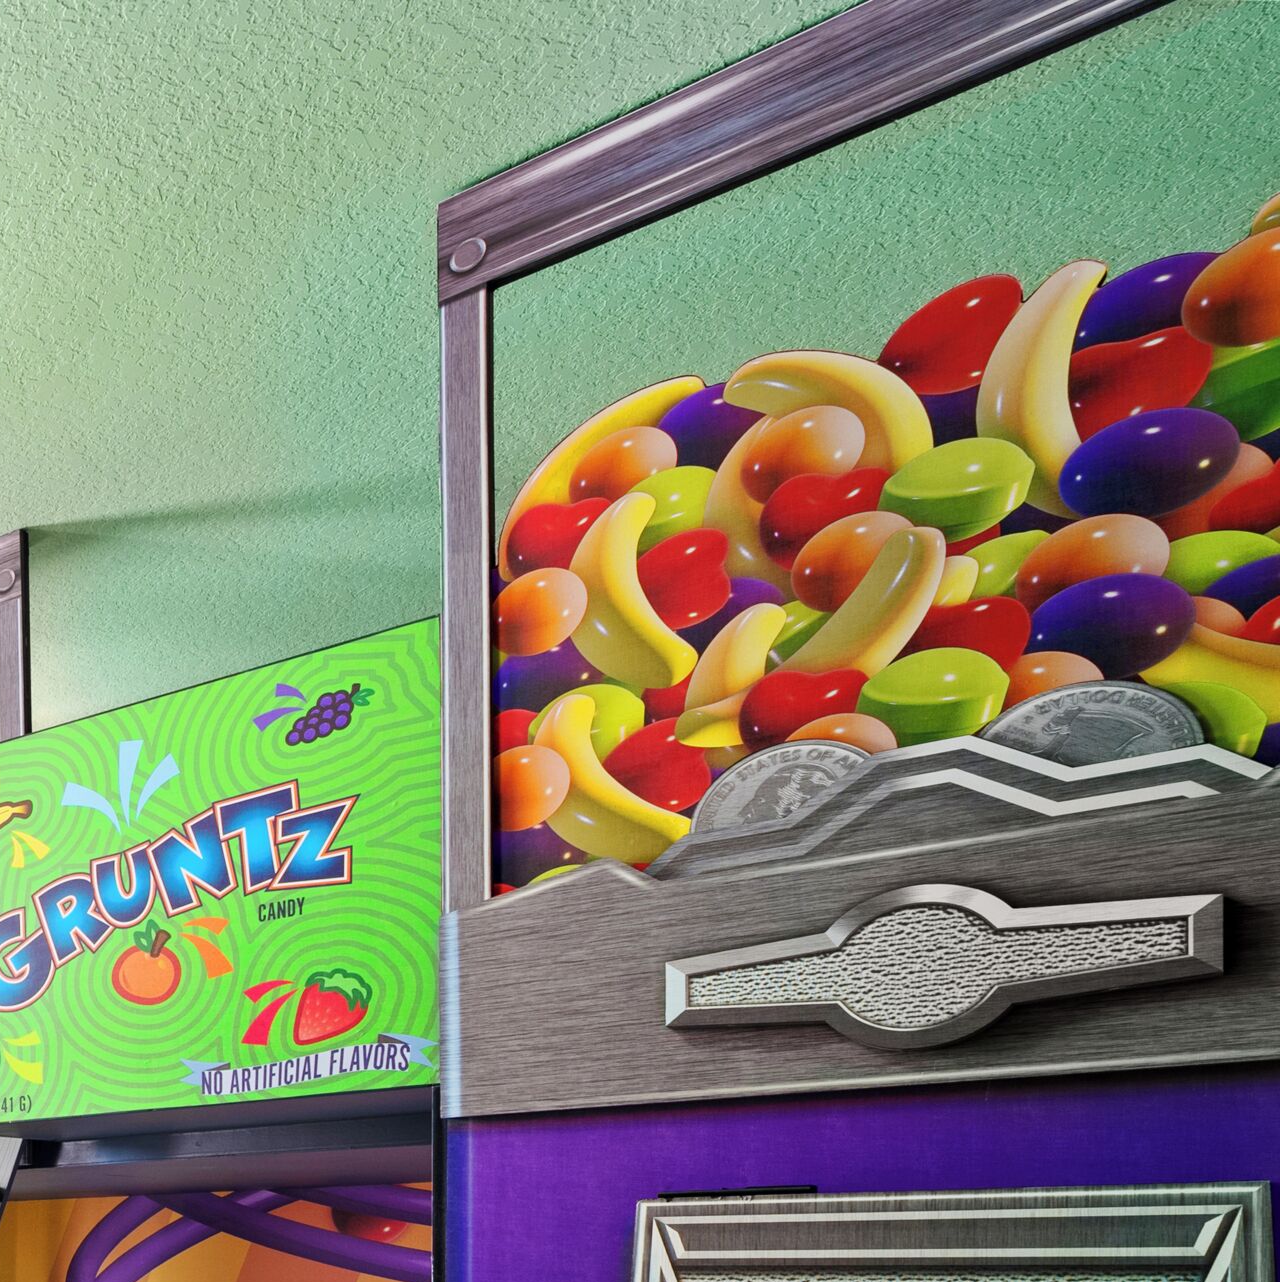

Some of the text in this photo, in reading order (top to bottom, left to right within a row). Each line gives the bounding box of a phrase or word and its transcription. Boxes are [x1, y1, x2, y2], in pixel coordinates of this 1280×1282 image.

[1034, 689, 1127, 715] DOLLAR
[735, 748, 801, 782] STATES
[805, 749, 835, 762] OF
[258, 896, 306, 923] CANDY
[201, 1043, 411, 1095] NO ARTIFICIAL FLAVORS
[19, 1094, 33, 1114] G)
